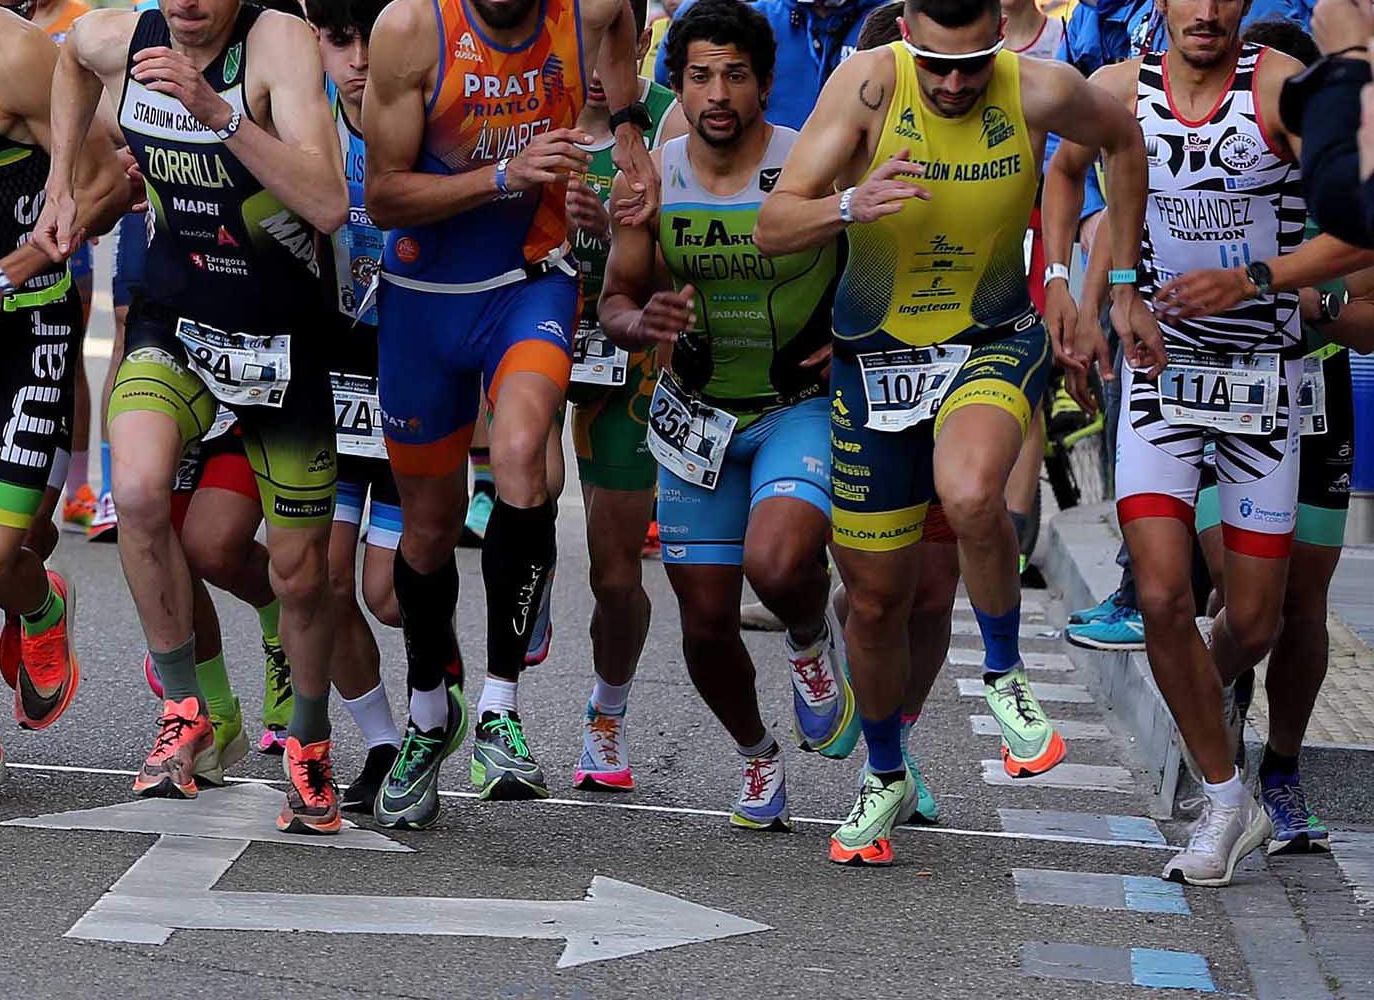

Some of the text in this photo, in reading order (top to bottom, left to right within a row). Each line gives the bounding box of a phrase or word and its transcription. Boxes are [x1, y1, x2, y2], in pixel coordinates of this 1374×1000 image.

[464, 69, 540, 99] PRAT
[133, 101, 174, 129] STADIUM
[462, 93, 540, 117] TRIATLÓ
[144, 145, 235, 188] ZORRILLA
[954, 154, 1021, 182] ALBACETE
[172, 197, 219, 216] MAPEI
[1154, 191, 1254, 230] FERNÁNDEZ
[1168, 227, 1246, 241] TRIATLON
[205, 254, 247, 266] Zaragoza
[207, 263, 249, 276] DEPORTE
[682, 253, 776, 281] MEDARD
[898, 301, 961, 315] Ingeteam
[1171, 373, 1230, 407] 11A
[335, 400, 373, 431] 7A
[653, 398, 691, 449] 25A
